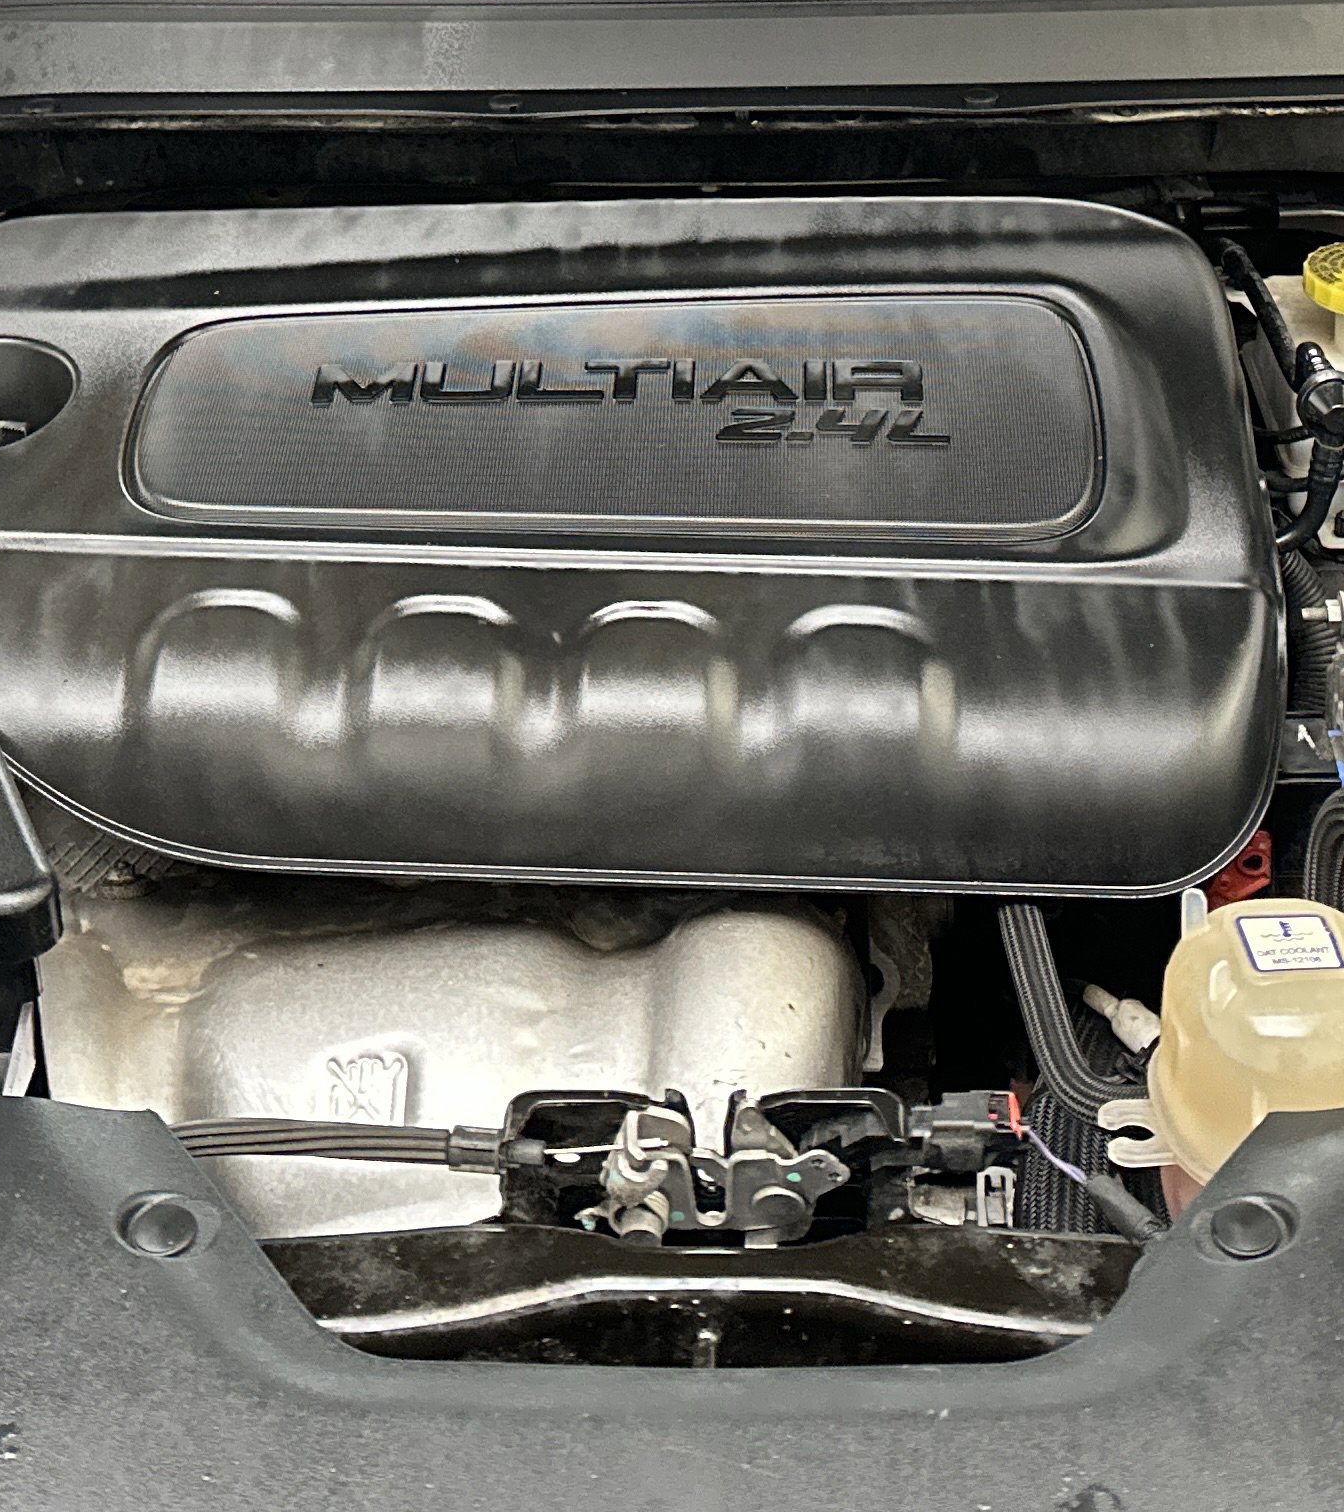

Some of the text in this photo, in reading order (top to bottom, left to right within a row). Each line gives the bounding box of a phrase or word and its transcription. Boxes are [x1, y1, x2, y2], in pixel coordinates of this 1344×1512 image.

[311, 359, 925, 406] MULTIAIR
[716, 406, 952, 445] 2.4L
[1279, 946, 1330, 955] COOLANT
